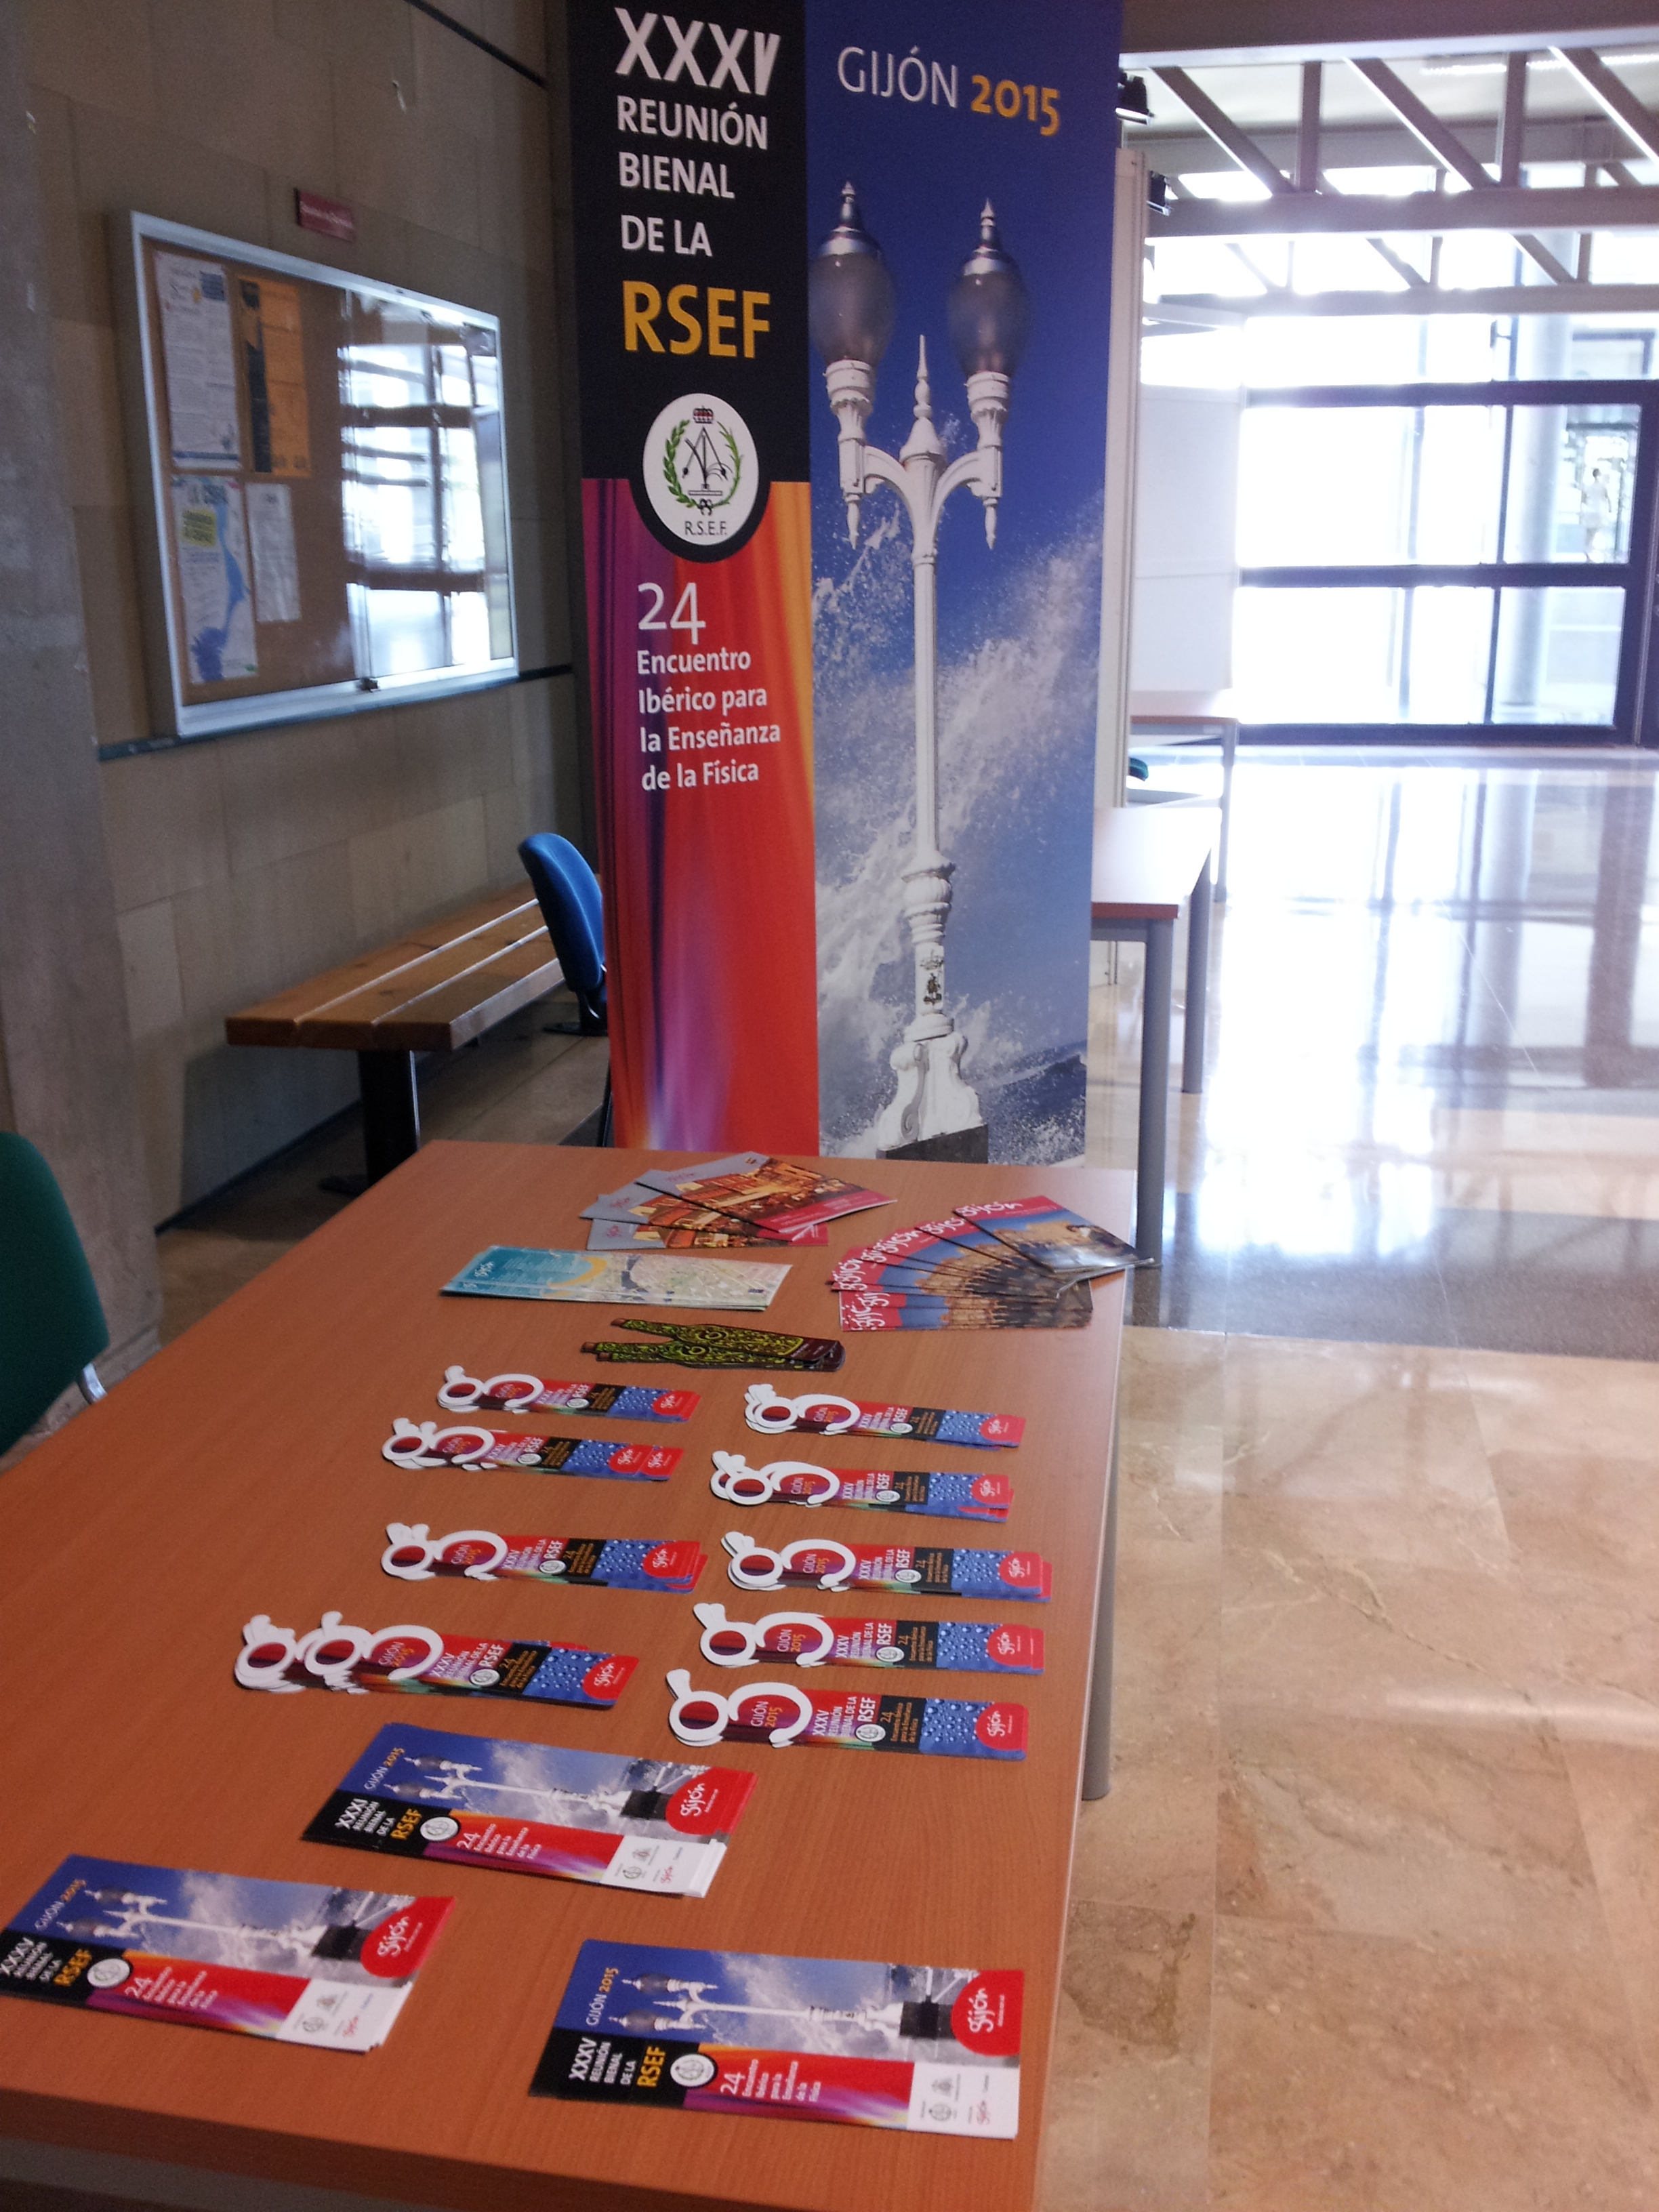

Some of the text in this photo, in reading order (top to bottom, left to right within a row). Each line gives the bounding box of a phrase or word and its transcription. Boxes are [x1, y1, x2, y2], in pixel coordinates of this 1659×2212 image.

[615, 7, 781, 96] XXXV
[838, 45, 1060, 135] GIJÓN 2015
[617, 95, 768, 150] REUNIÓN
[619, 152, 735, 199] BIENAL
[620, 214, 713, 257] DE LA
[623, 280, 771, 358] RSEF
[638, 581, 706, 644] 24
[637, 647, 751, 675] Encuentro
[639, 687, 767, 715] Ibérico para
[640, 722, 781, 752] la Enseñanza
[641, 759, 758, 791] de la Física
[876, 1473, 890, 1489] RSEF
[543, 1540, 564, 1558] RSEF
[895, 1549, 910, 1568] RSEF
[776, 1629, 792, 1652] GIJÓN
[790, 1634, 806, 1652] 2015
[835, 1635, 849, 1657] XXXV
[876, 1622, 892, 1645] RSEF
[897, 1635, 912, 1645] 24
[428, 1652, 456, 1677] XXXV
[477, 1643, 506, 1666] RSEF
[748, 1700, 769, 1726] GIJÓN
[764, 1706, 783, 1727] 2015
[812, 1709, 830, 1736] XXXV
[827, 1706, 842, 1736] REUNIÓN
[840, 1696, 857, 1736] BIENAL DE LA
[857, 1697, 876, 1721] RSEF
[880, 1711, 895, 1722] 24
[375, 1816, 397, 1836] DE LA
[388, 1808, 426, 1840] RSEF
[455, 1831, 482, 1849] 24
[125, 1977, 152, 1998] 24
[581, 1967, 620, 2025] GIJÓN 2015
[568, 2036, 598, 2079] XXXV
[588, 2041, 611, 2081] REUNIÓN
[603, 2052, 623, 2083] BIENAL
[636, 2046, 667, 2086] RSEF
[619, 2060, 636, 2085] DE LA
[719, 2071, 746, 2094] 24
